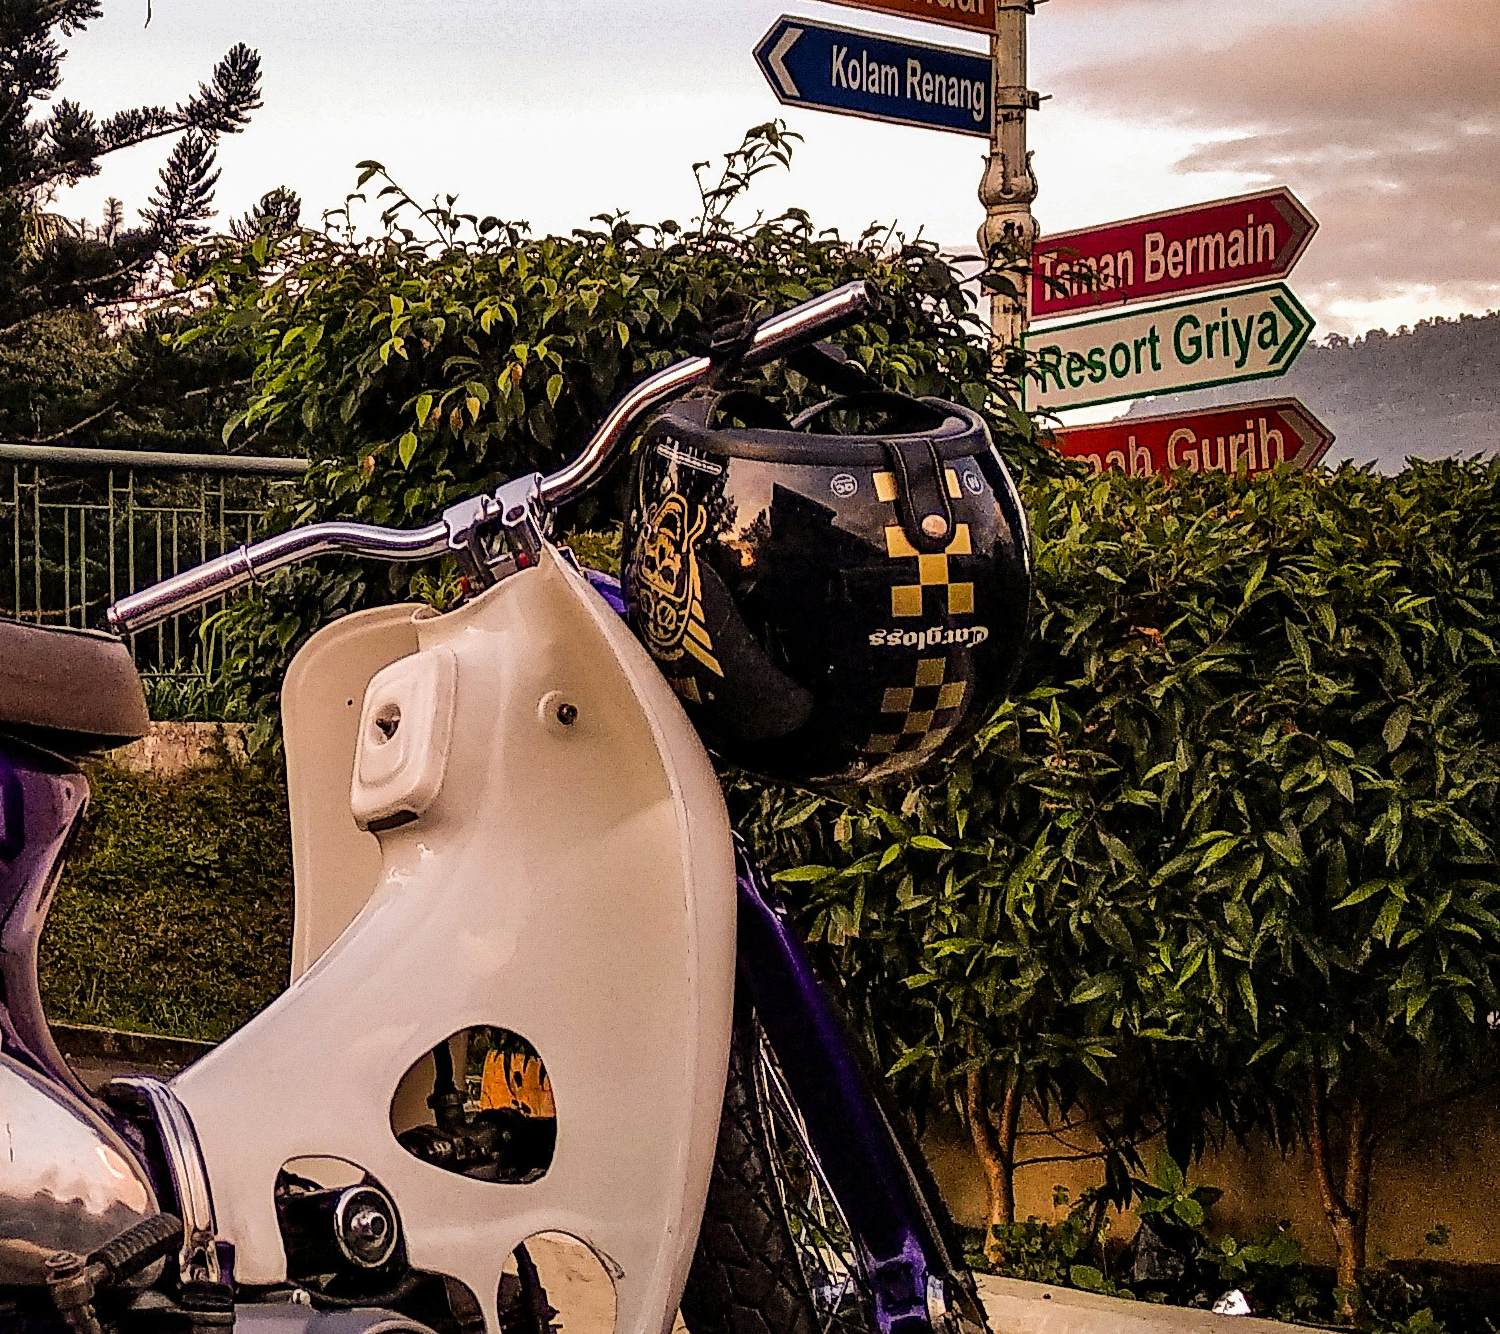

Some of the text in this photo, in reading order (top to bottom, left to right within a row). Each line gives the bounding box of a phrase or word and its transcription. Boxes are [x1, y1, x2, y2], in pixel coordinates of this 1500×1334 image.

[831, 45, 986, 122] Kolam Renang
[1145, 213, 1275, 283] Bermain
[1039, 307, 1280, 394] Resort Griya
[1167, 417, 1285, 474] Gurih
[868, 625, 990, 650] Cargloss
